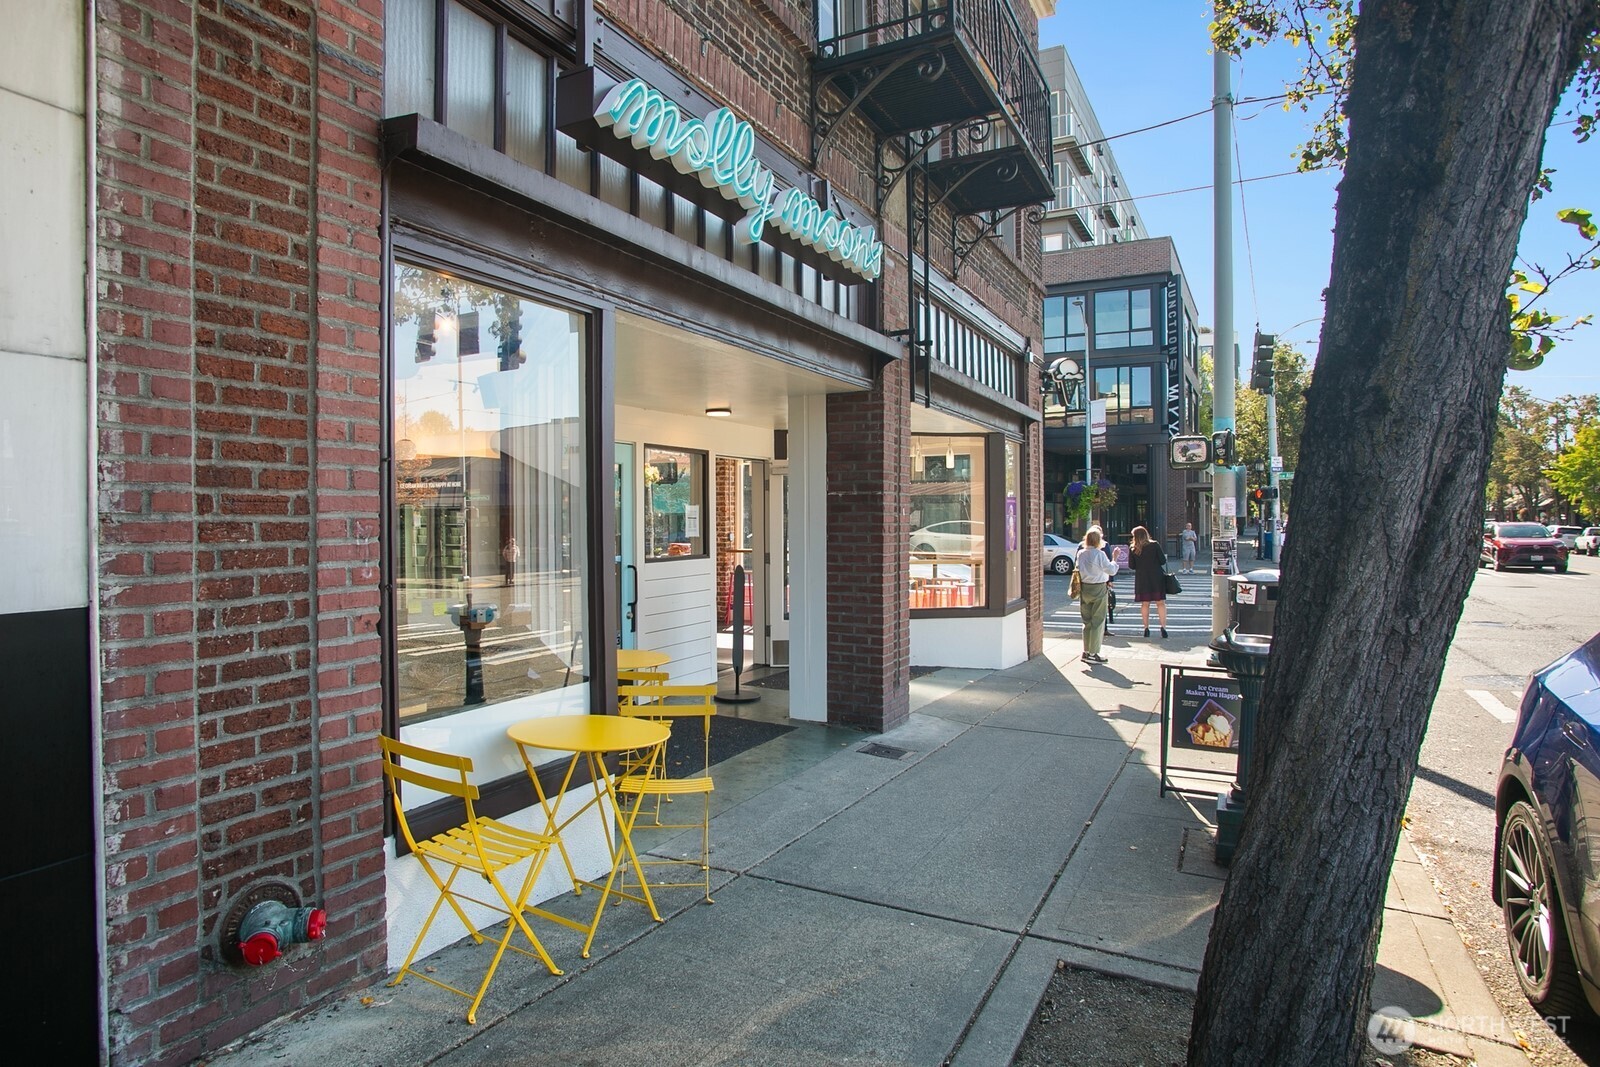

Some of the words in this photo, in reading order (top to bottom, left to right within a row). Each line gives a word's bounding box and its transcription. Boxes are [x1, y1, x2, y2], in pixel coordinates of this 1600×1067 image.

[597, 78, 775, 244] molly
[1167, 281, 1177, 355] JUNCTION
[1219, 692, 1239, 700] Happy
